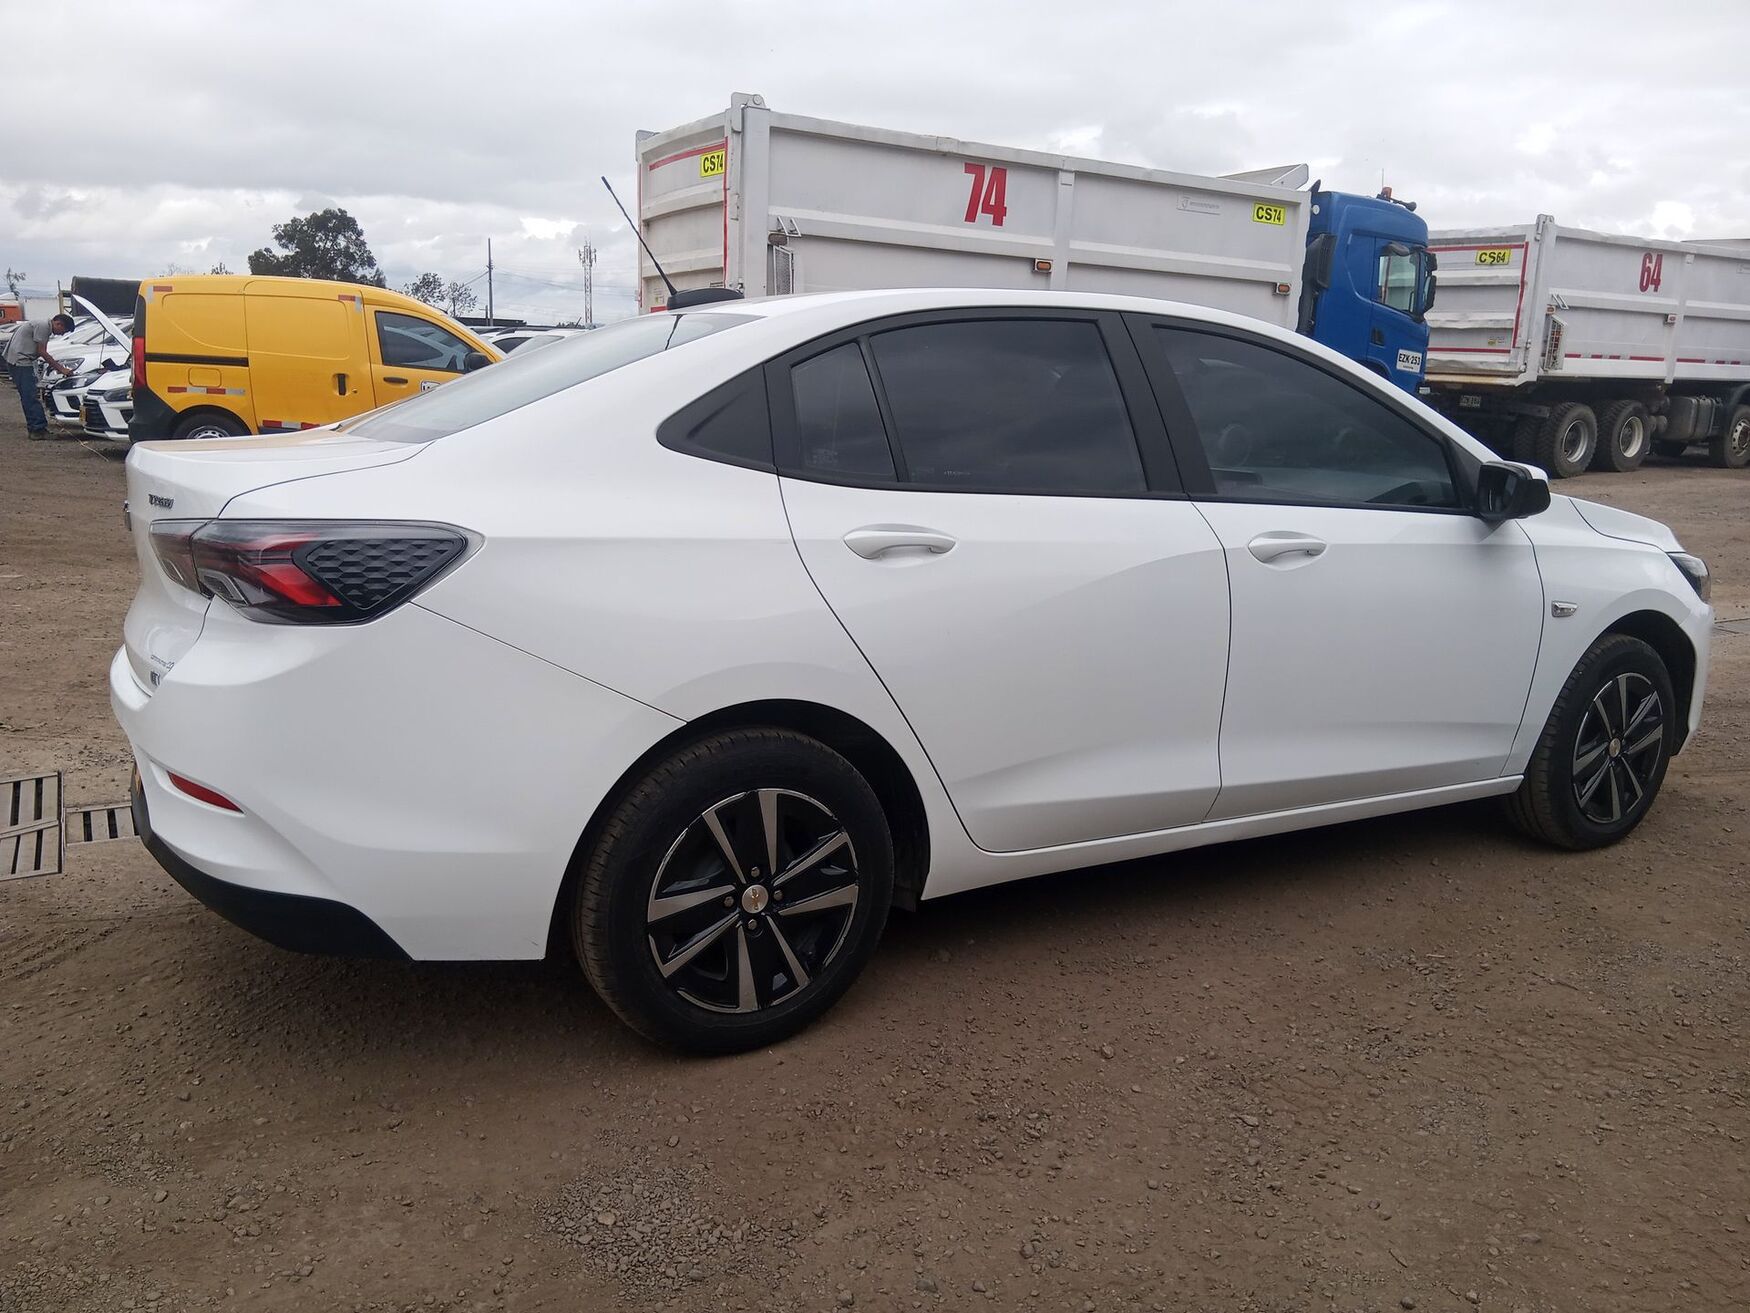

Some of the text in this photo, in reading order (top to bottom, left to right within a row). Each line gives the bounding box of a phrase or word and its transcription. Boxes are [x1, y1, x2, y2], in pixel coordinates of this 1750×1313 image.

[703, 153, 724, 173] CS74
[964, 162, 1007, 227] 74
[1256, 206, 1281, 222] CS74
[1479, 251, 1506, 263] CS64
[1639, 252, 1663, 293] 64
